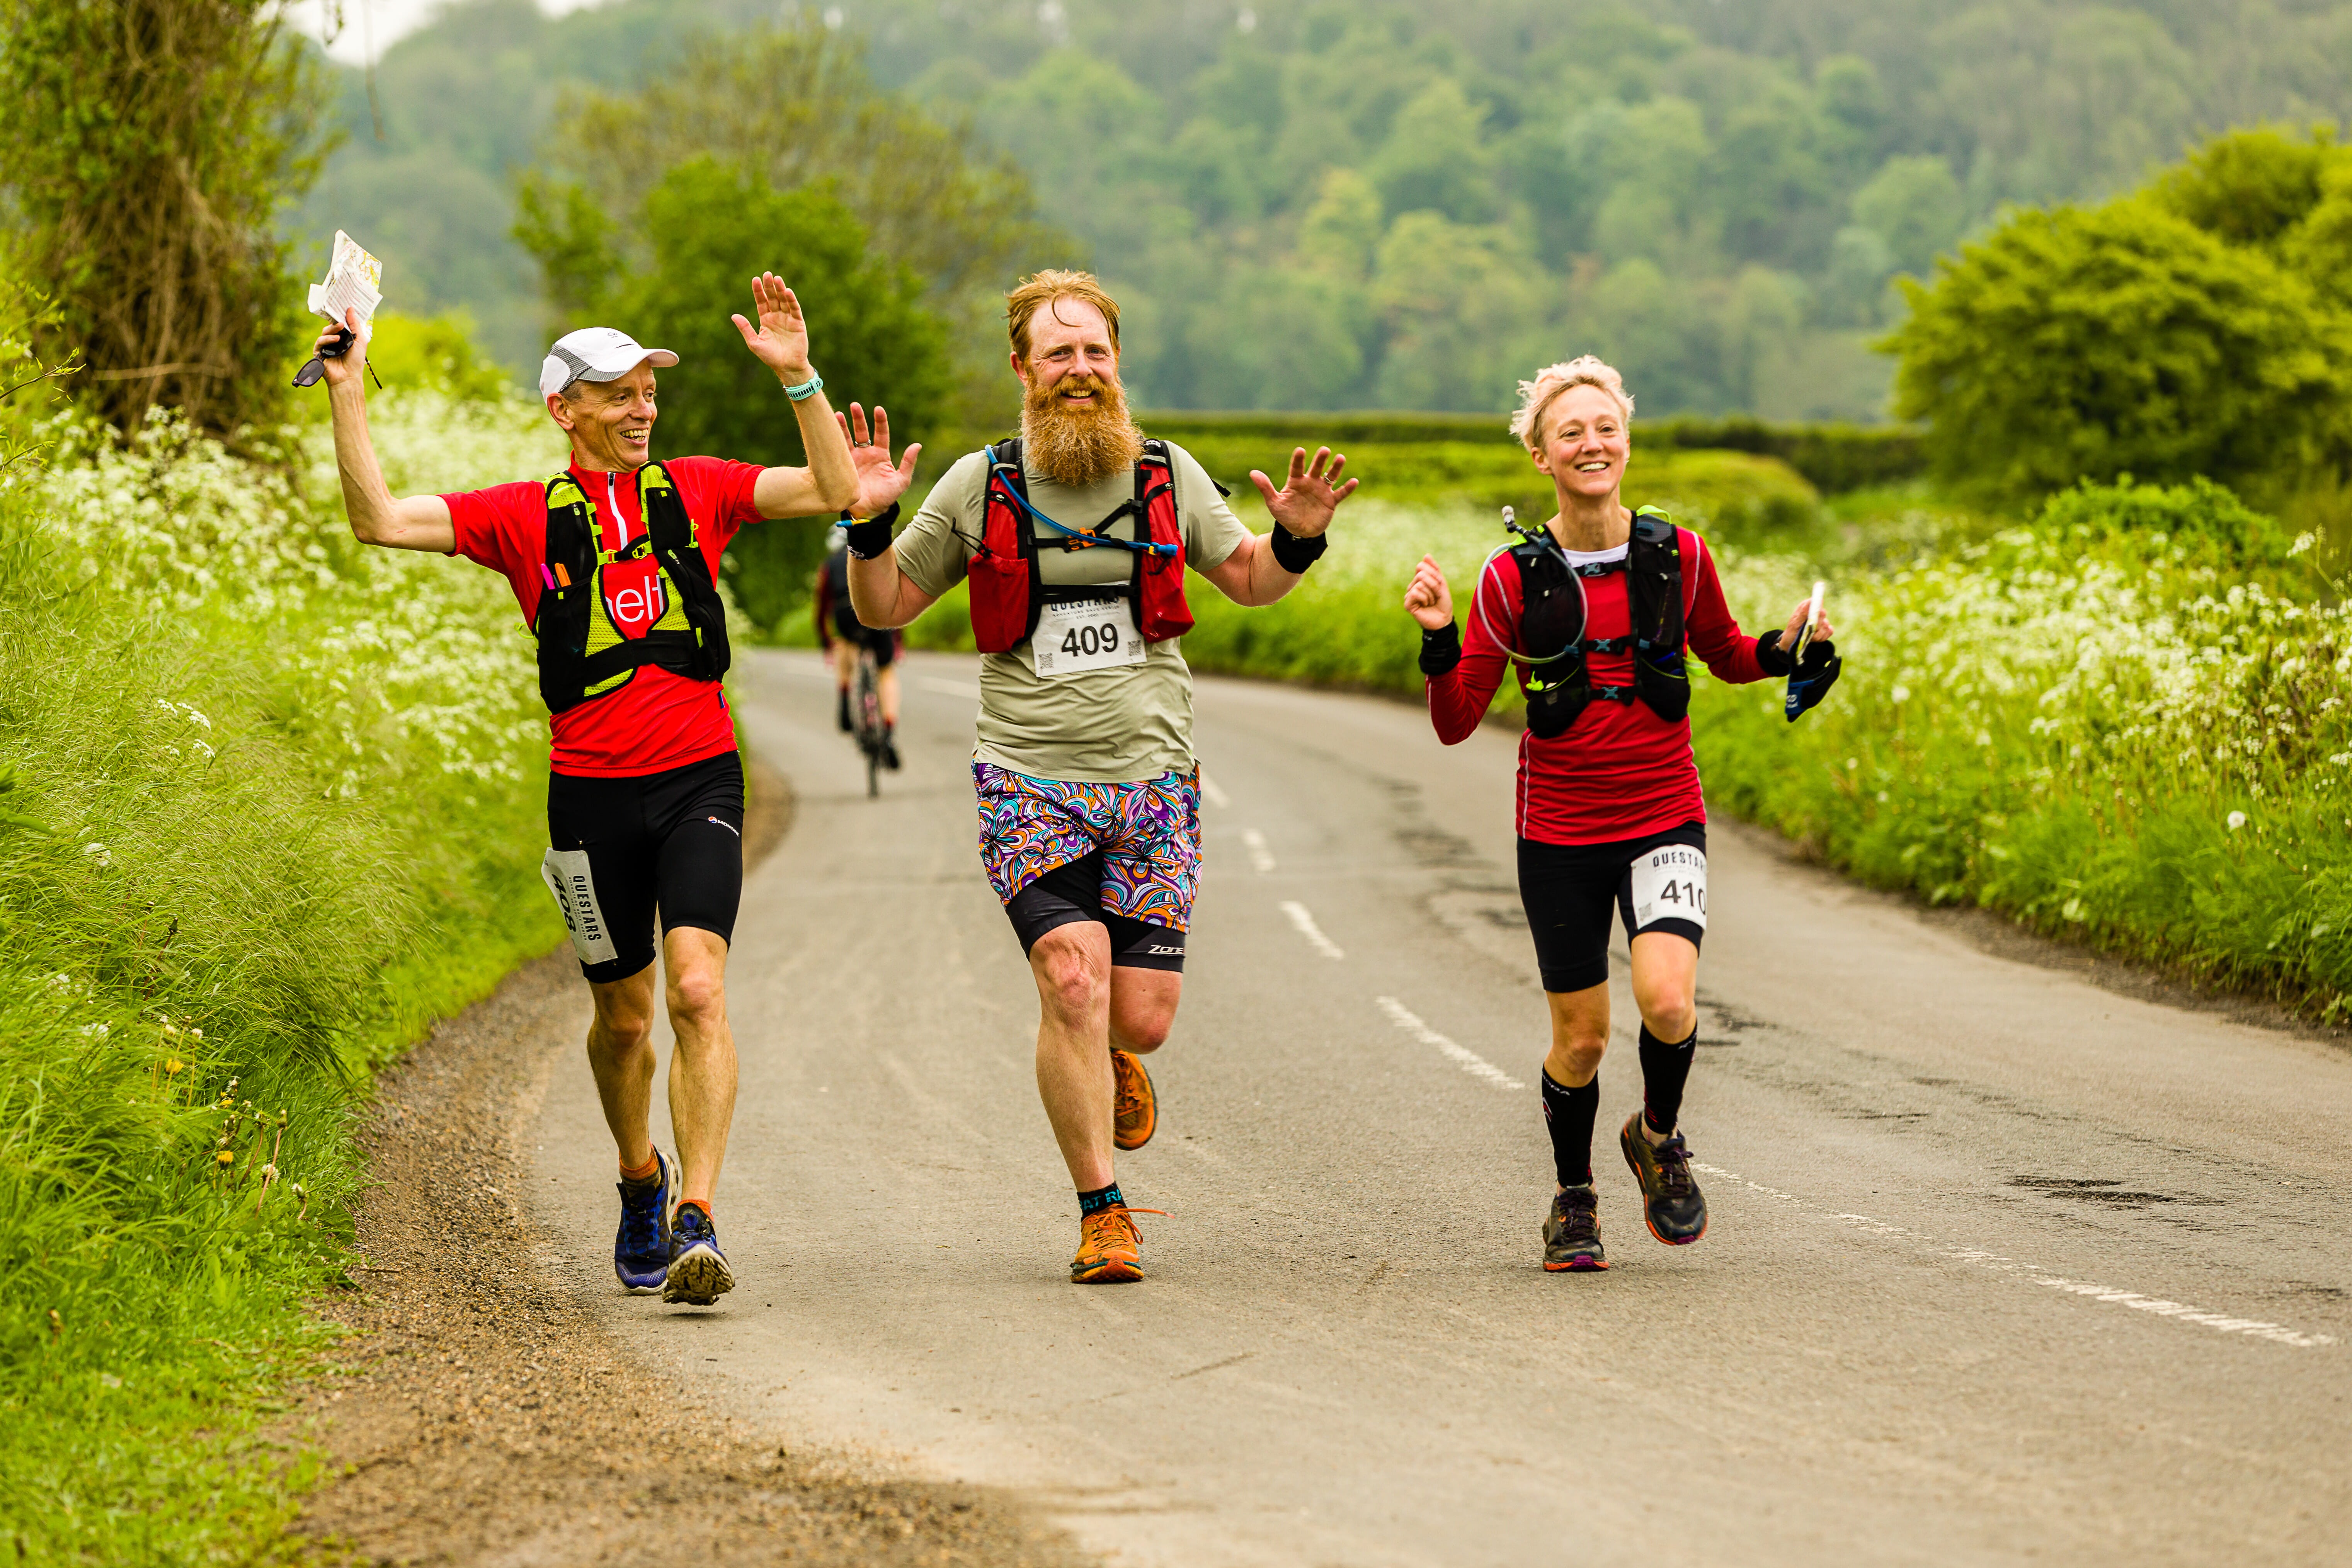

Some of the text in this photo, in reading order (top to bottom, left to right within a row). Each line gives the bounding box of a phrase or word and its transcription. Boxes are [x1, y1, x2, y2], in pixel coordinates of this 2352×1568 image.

[605, 575, 664, 622] elt
[1061, 623, 1118, 657] 409
[551, 874, 576, 932] 408
[573, 875, 601, 941] QUESTARS
[1661, 880, 1706, 915] 410
